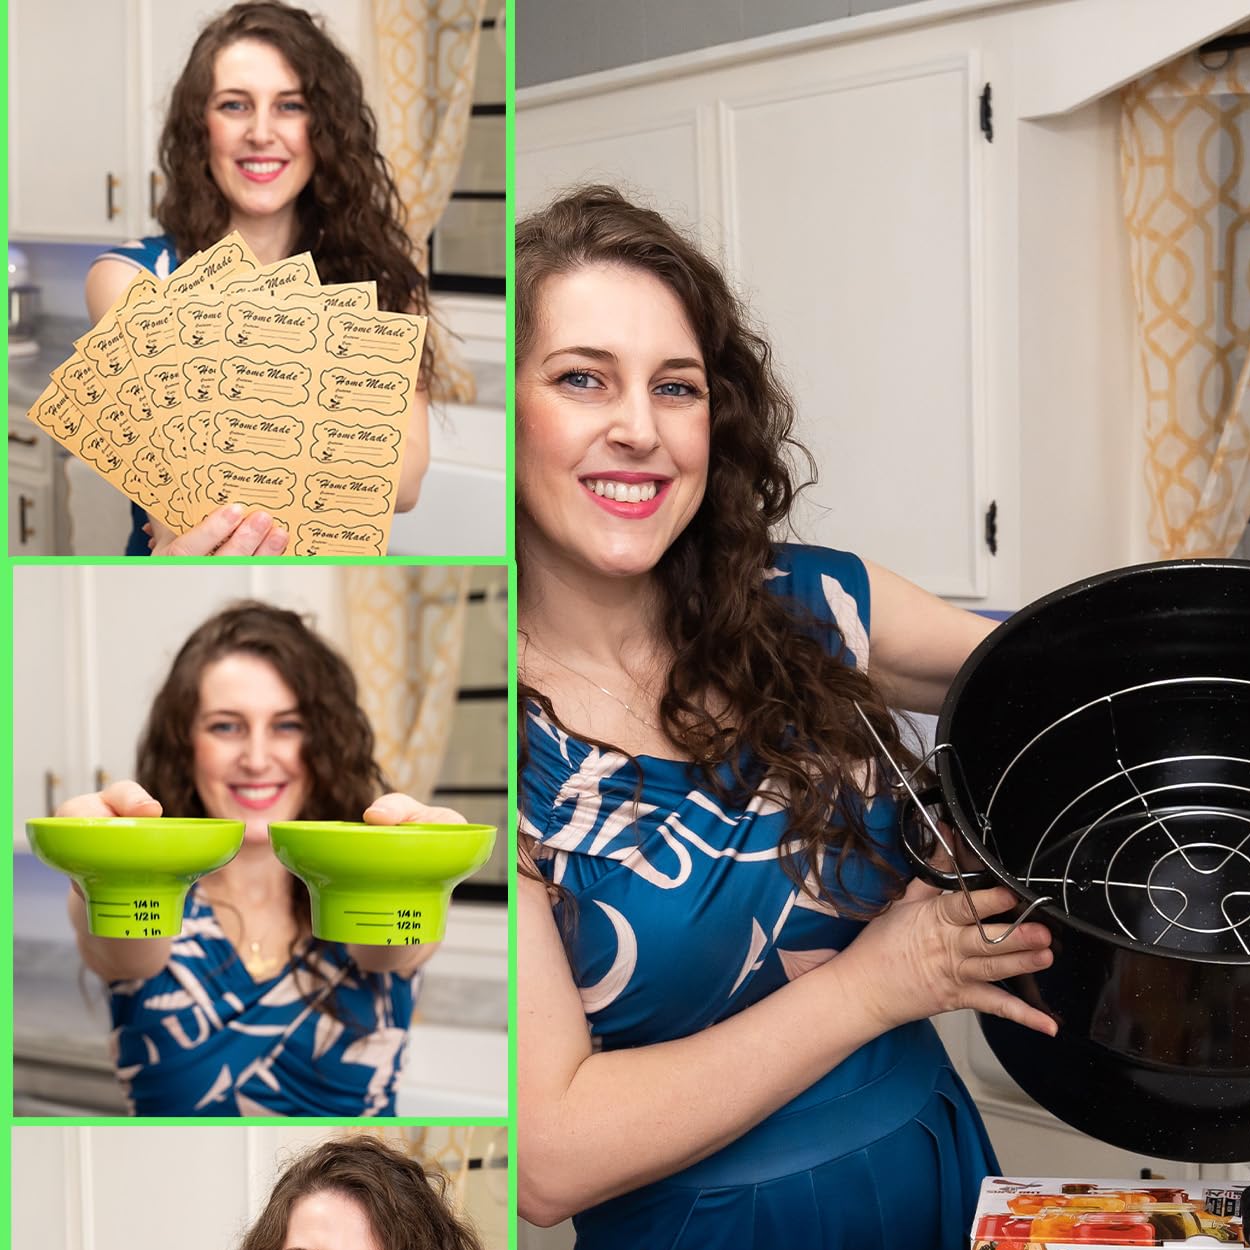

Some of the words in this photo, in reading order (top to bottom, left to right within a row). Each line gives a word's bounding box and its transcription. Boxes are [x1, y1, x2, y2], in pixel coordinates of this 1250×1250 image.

[133, 899, 148, 909] 1/4
[133, 912, 149, 921] 1/2
[396, 909, 411, 918] 1/4
[396, 921, 411, 930] 1/2
